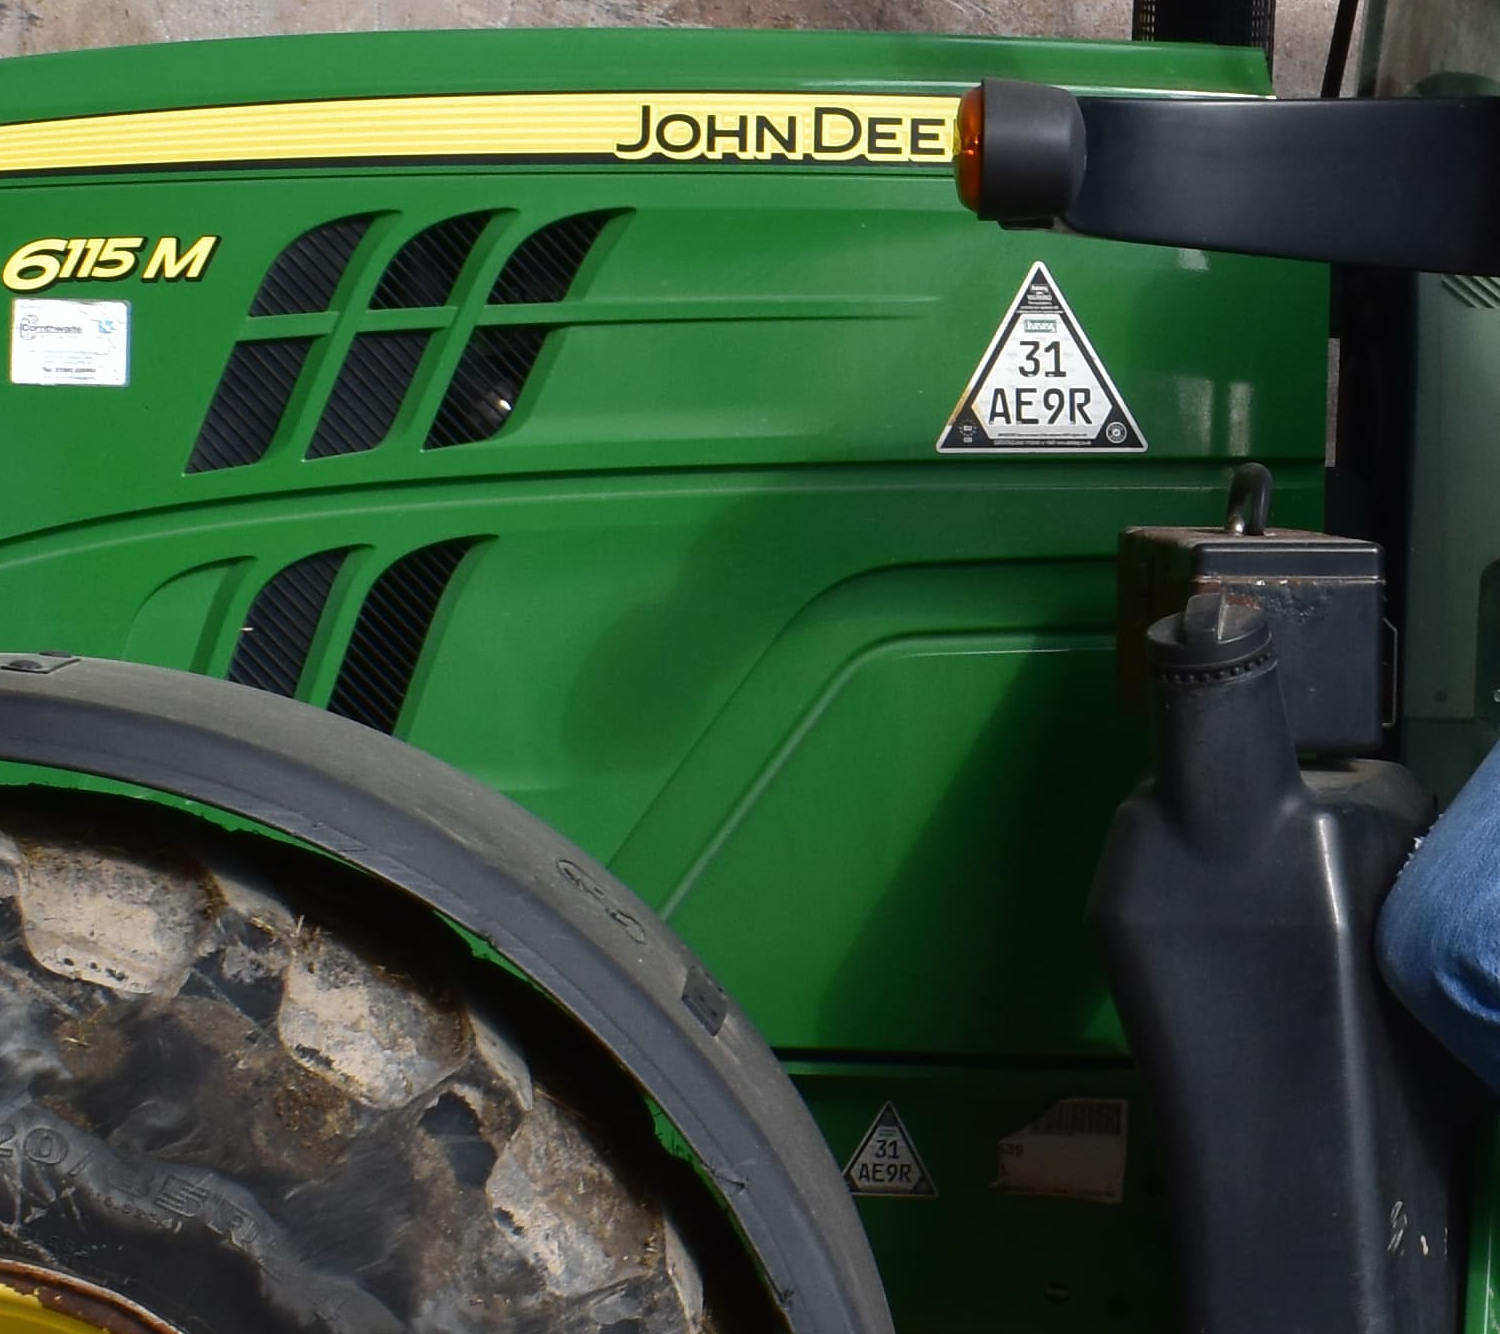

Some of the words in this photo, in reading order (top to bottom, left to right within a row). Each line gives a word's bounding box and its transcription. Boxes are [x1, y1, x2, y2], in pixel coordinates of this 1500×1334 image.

[616, 104, 798, 154] JOHN
[813, 106, 946, 155] DEE
[1018, 340, 1067, 378] 31
[989, 387, 1093, 425] AE9R
[875, 1139, 900, 1160] 31
[859, 1163, 912, 1184] AE9R
